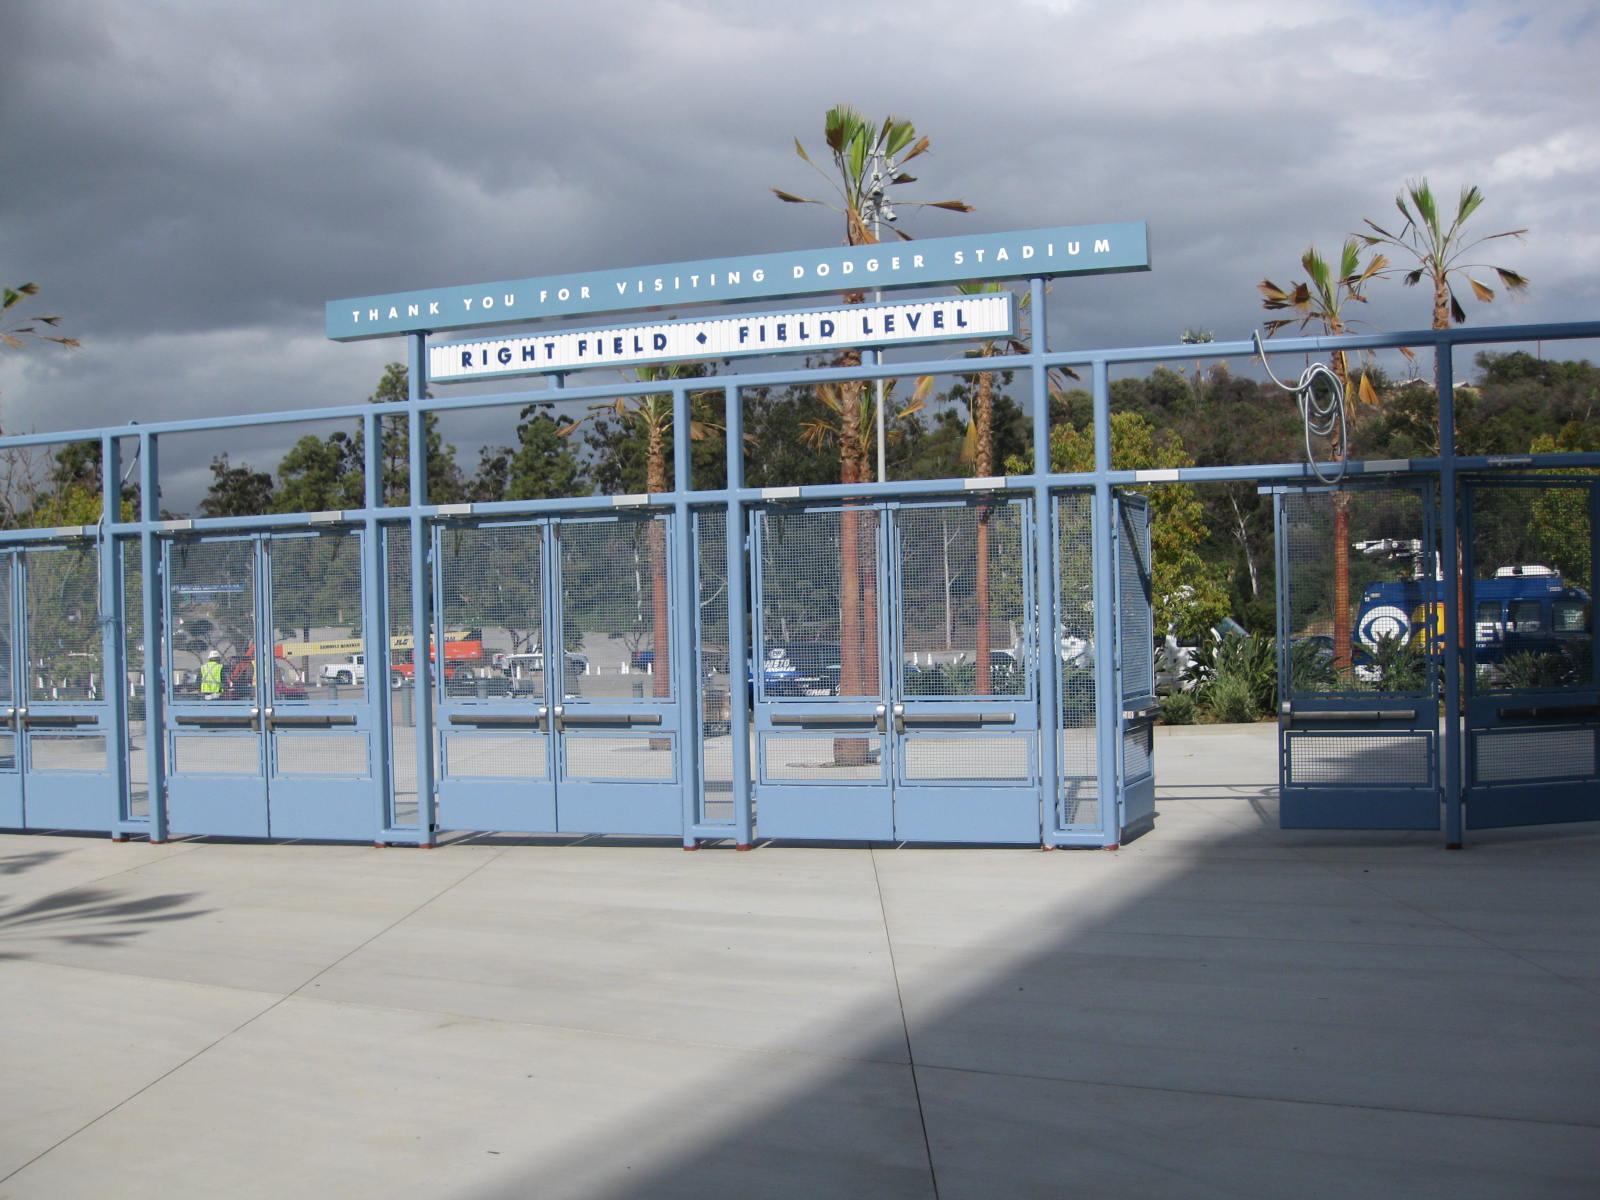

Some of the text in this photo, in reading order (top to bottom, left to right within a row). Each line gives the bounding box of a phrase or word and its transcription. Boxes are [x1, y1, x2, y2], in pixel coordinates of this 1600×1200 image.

[352, 238, 1111, 323] THANK YOU FOR VISITING DODGER STADIUM
[461, 309, 968, 368] RIGHT FIELD FIELD LEVEL
